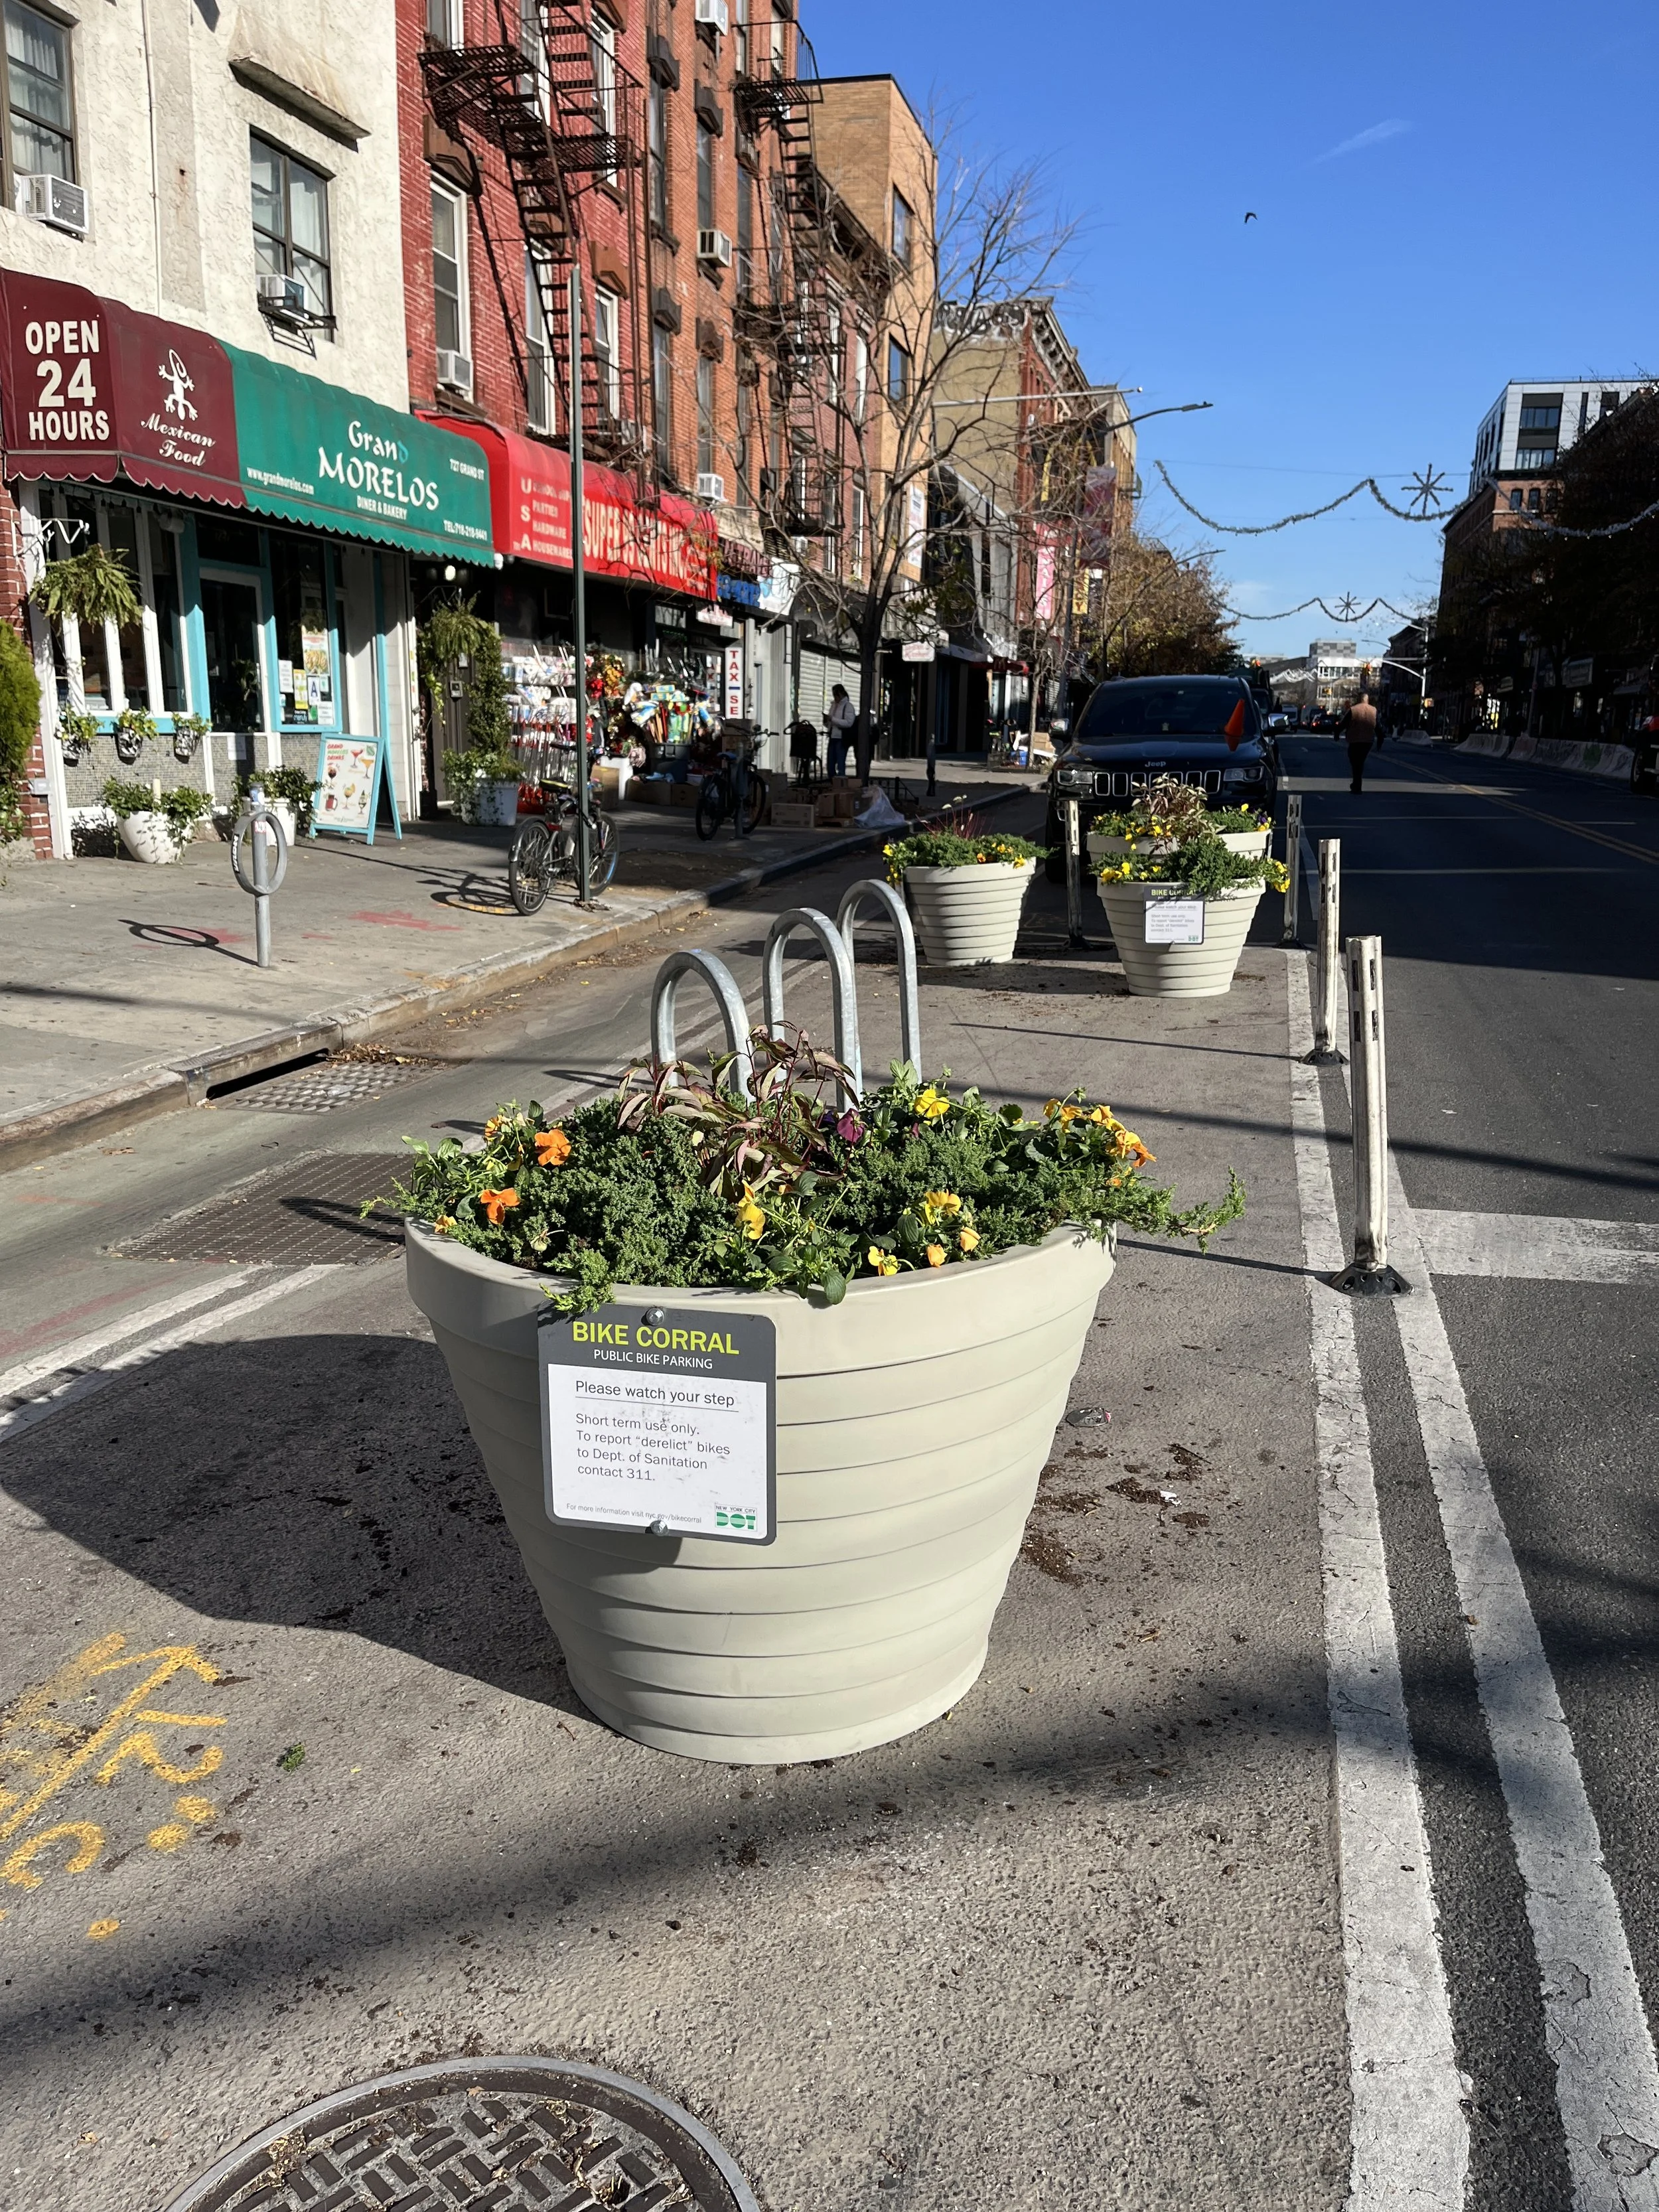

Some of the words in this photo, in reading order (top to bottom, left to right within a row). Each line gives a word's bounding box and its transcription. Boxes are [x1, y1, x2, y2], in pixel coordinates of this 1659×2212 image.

[25, 320, 100, 355] OPEN
[36, 358, 96, 407] 24
[29, 410, 109, 442] HOURS
[141, 413, 216, 449] Mexican
[159, 439, 206, 467] Food
[246, 467, 315, 496] www.grandmorelos.com
[319, 446, 440, 510] MORELOS
[460, 462, 477, 480] GRAND
[477, 469, 485, 481] ST
[356, 495, 377, 513] DINER
[383, 502, 408, 520] BAKERY
[583, 498, 621, 562] SUPER
[729, 650, 739, 682] TAX
[572, 1321, 628, 1345] BIKE
[636, 1327, 740, 1355] CORRAL
[593, 1349, 633, 1363] PUBLIC
[636, 1353, 660, 1364] BIKE
[663, 1355, 713, 1370] PARKING
[575, 1380, 621, 1396] Please
[625, 1384, 666, 1400] watch
[670, 1392, 700, 1403] your
[704, 1394, 735, 1408] step
[576, 1412, 609, 1427] Short
[612, 1418, 641, 1429] term
[645, 1422, 668, 1432] use
[671, 1422, 700, 1436] only.
[576, 1430, 591, 1442] To
[595, 1432, 632, 1447] report
[636, 1435, 693, 1451] “derelict”
[697, 1441, 731, 1455] bikes
[577, 1447, 589, 1459] to
[593, 1448, 625, 1463] Dept.
[628, 1451, 642, 1463] of
[644, 1453, 707, 1470] Sanitation
[577, 1465, 623, 1479] contact
[626, 1469, 656, 1481] 311.
[595, 1506, 630, 1516] information
[631, 1509, 644, 1518] visit
[716, 1512, 756, 1530] DOT
